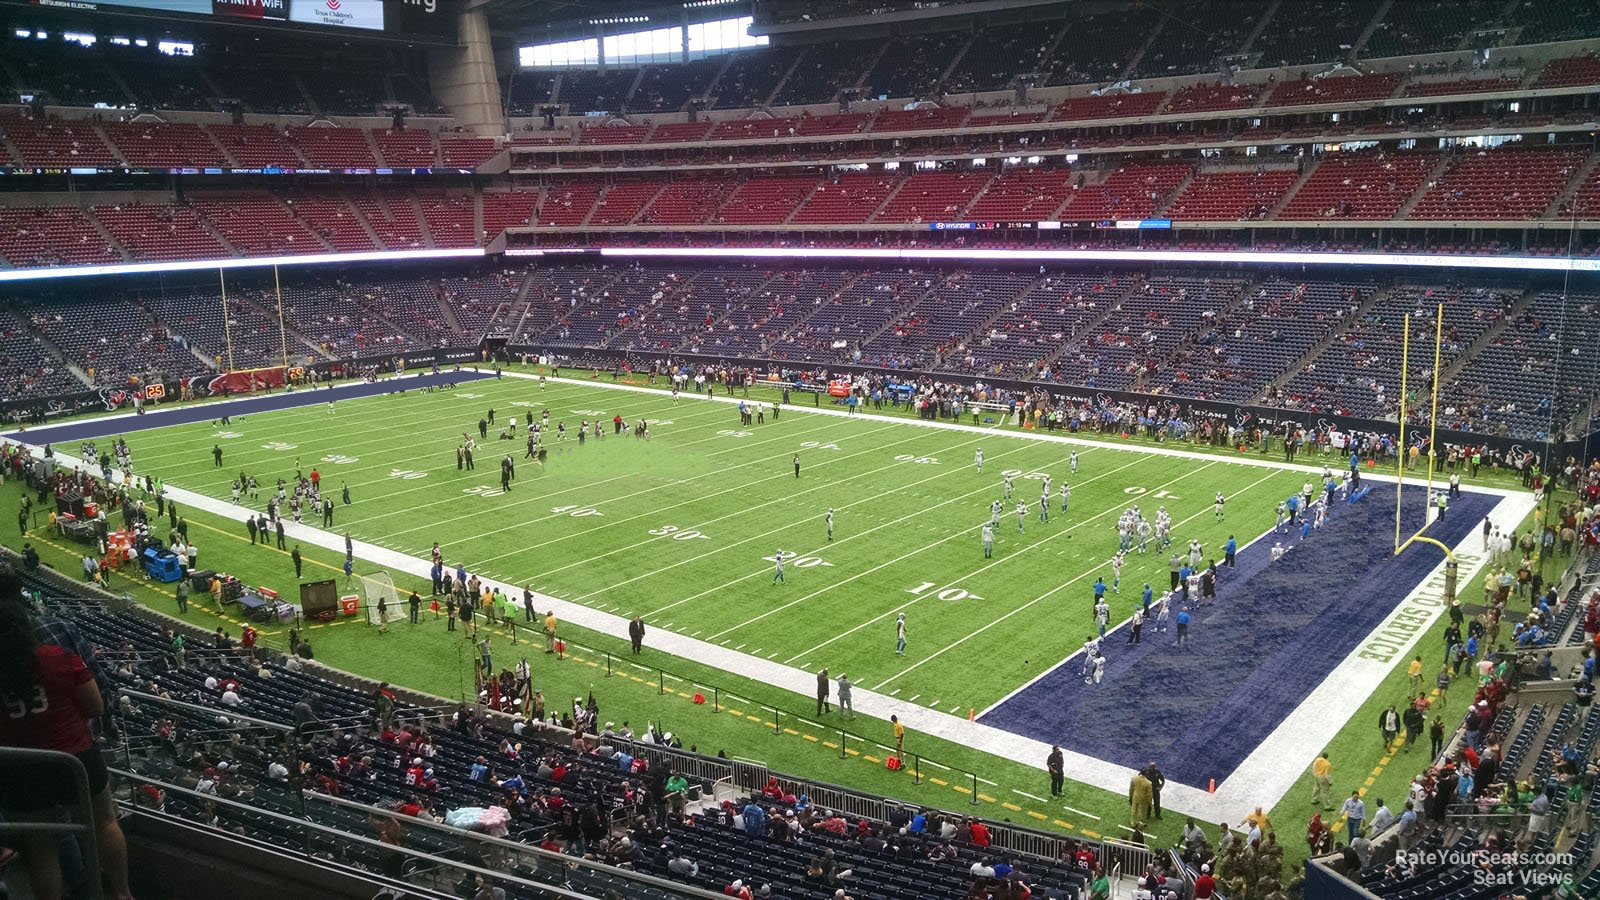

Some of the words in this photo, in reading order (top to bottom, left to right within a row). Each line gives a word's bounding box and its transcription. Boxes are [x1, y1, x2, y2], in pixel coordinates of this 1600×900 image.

[71, 2, 97, 11] ELECTRIC
[314, 9, 329, 18] Texas
[329, 11, 354, 20] Children's
[323, 17, 345, 25] Hospital
[409, 356, 436, 364] TEXANS
[148, 385, 164, 397] 25
[463, 485, 505, 498] 50
[550, 504, 598, 518] 40
[648, 525, 701, 541] 30
[904, 581, 970, 601] 10
[1358, 606, 1433, 663] SERVICE
[405, 772, 417, 785] 99
[1078, 860, 1089, 870] 99
